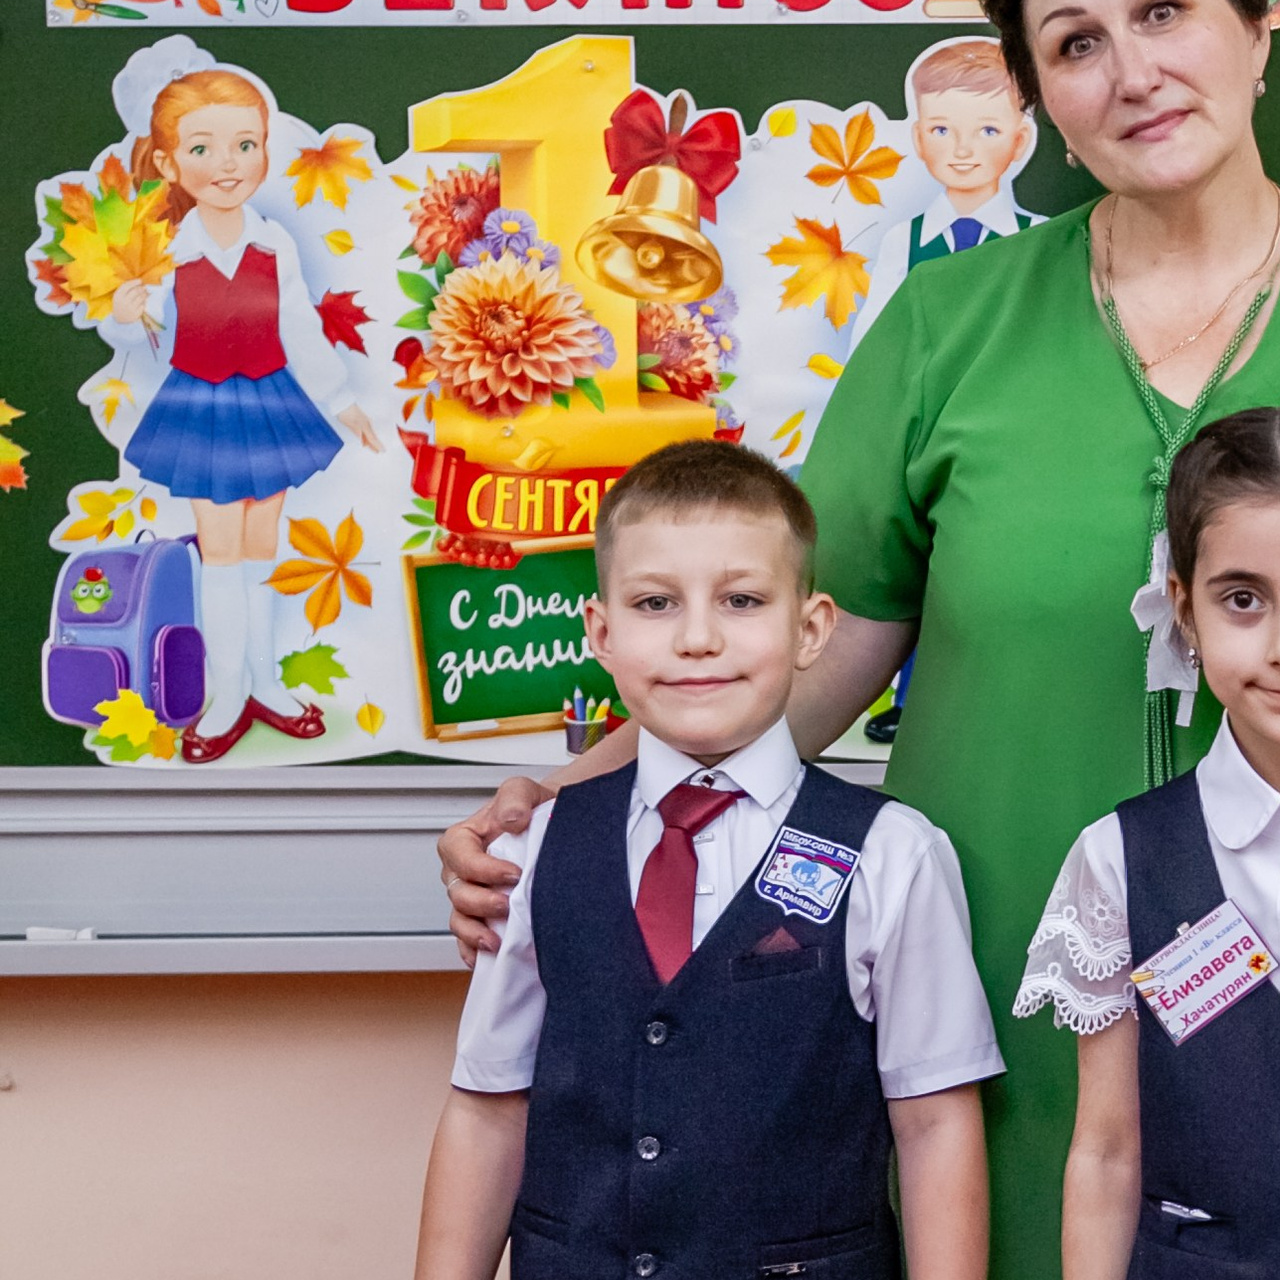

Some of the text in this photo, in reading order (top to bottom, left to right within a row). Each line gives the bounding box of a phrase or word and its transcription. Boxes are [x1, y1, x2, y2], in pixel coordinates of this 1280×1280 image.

[466, 473, 618, 533] СЕНТЯ
[1158, 935, 1256, 1011] Елизавета
[1180, 971, 1253, 1027] Хачатурян
